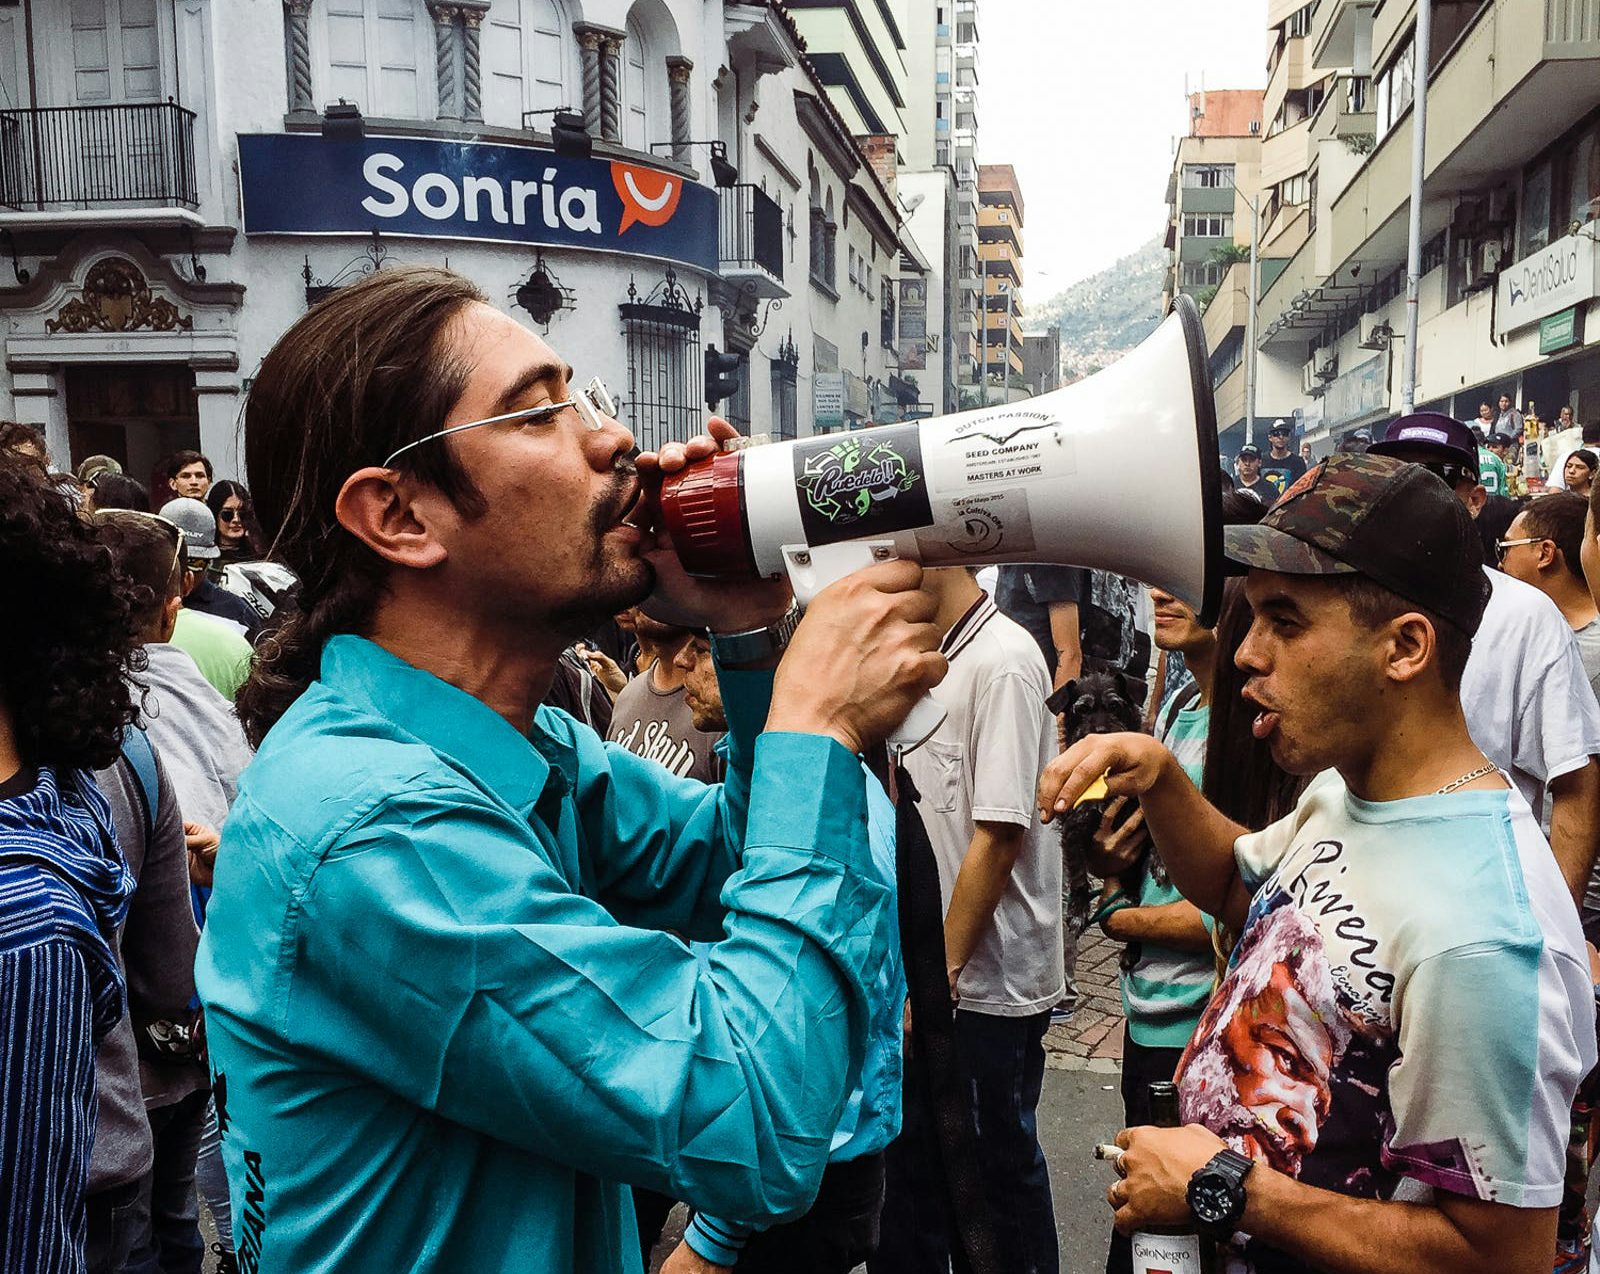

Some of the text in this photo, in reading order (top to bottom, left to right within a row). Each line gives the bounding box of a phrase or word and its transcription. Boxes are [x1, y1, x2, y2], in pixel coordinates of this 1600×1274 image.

[361, 153, 602, 235] Sonría
[955, 411, 1049, 434] DUTCH PASSION
[966, 442, 1040, 459] SEED COMPANY
[967, 465, 1042, 482] MASTERS AT WORK
[1290, 840, 1396, 1003] Rivera
[237, 1150, 266, 1274] BIANA
